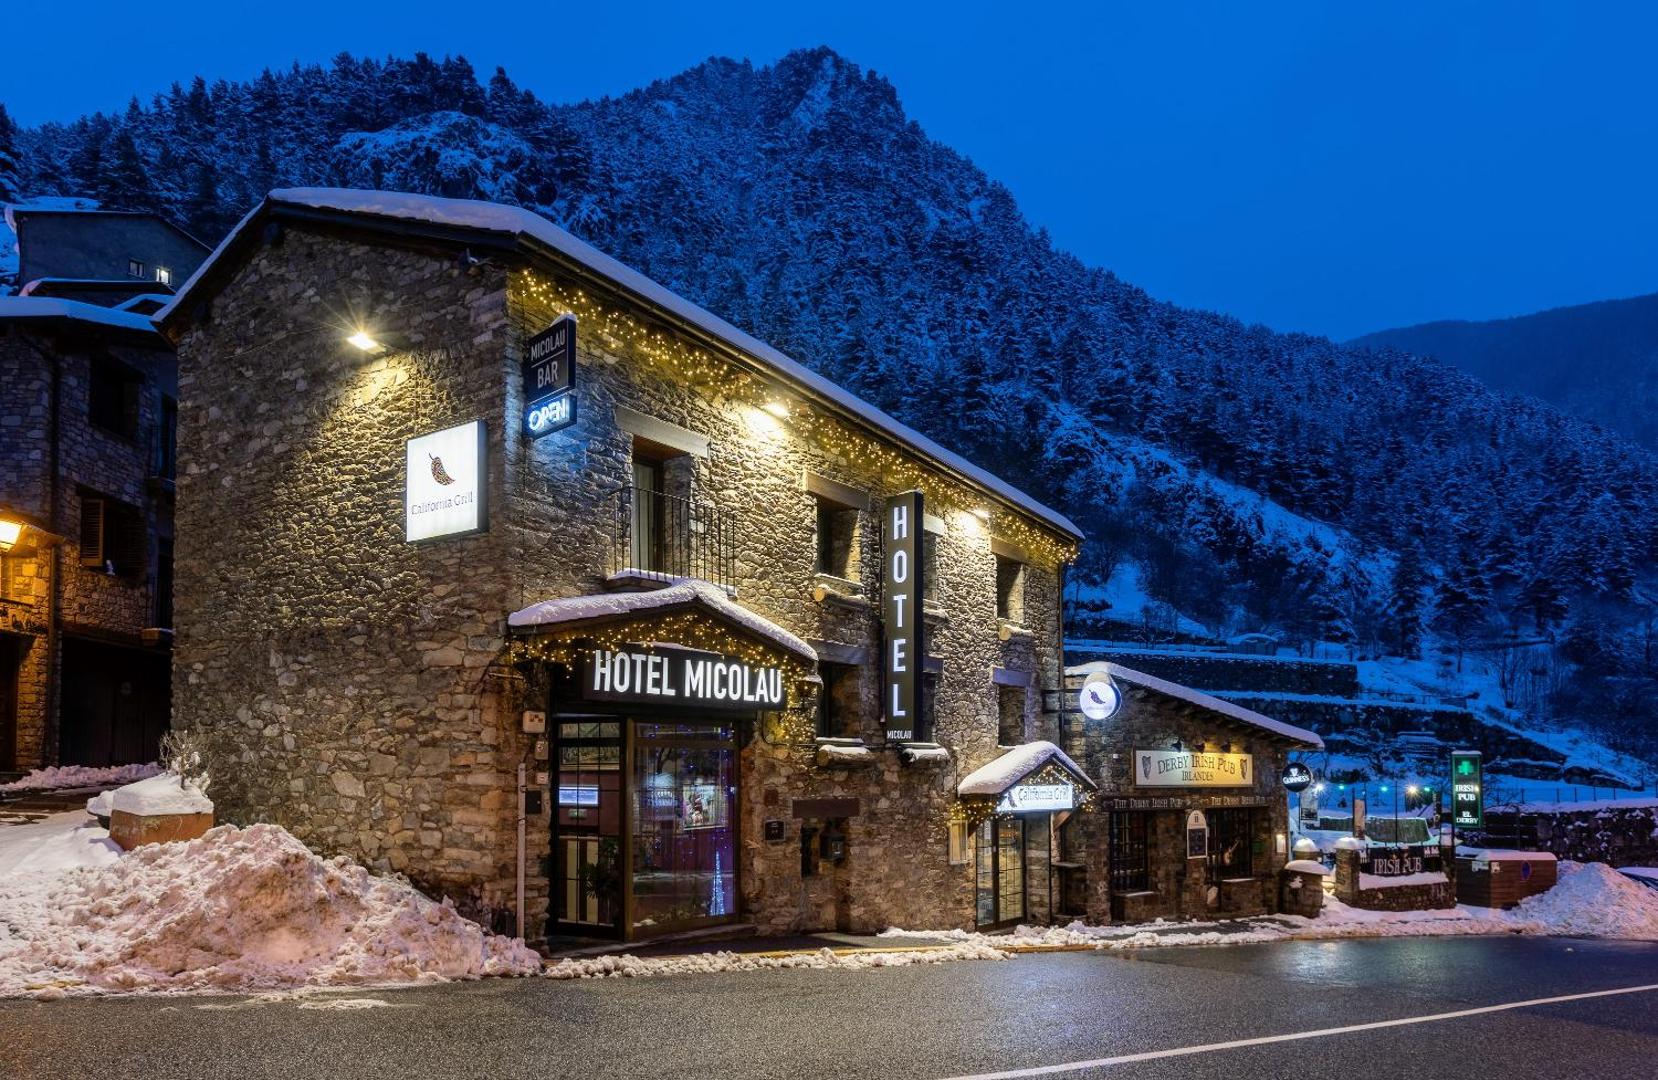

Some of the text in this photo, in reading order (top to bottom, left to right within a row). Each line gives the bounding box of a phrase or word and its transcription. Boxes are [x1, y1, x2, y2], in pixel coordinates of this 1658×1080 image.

[531, 329, 566, 361] MICOLAU
[537, 361, 559, 389] BAR
[528, 398, 567, 431] OPEN
[892, 505, 907, 717] HOTEL
[593, 649, 782, 704] HOTEL MICOLAU
[886, 730, 912, 739] MICOLAU
[1157, 754, 1236, 775] DERBY IRISH PUB
[1457, 793, 1476, 801] PUB
[1374, 857, 1423, 874] IRISH PUB
